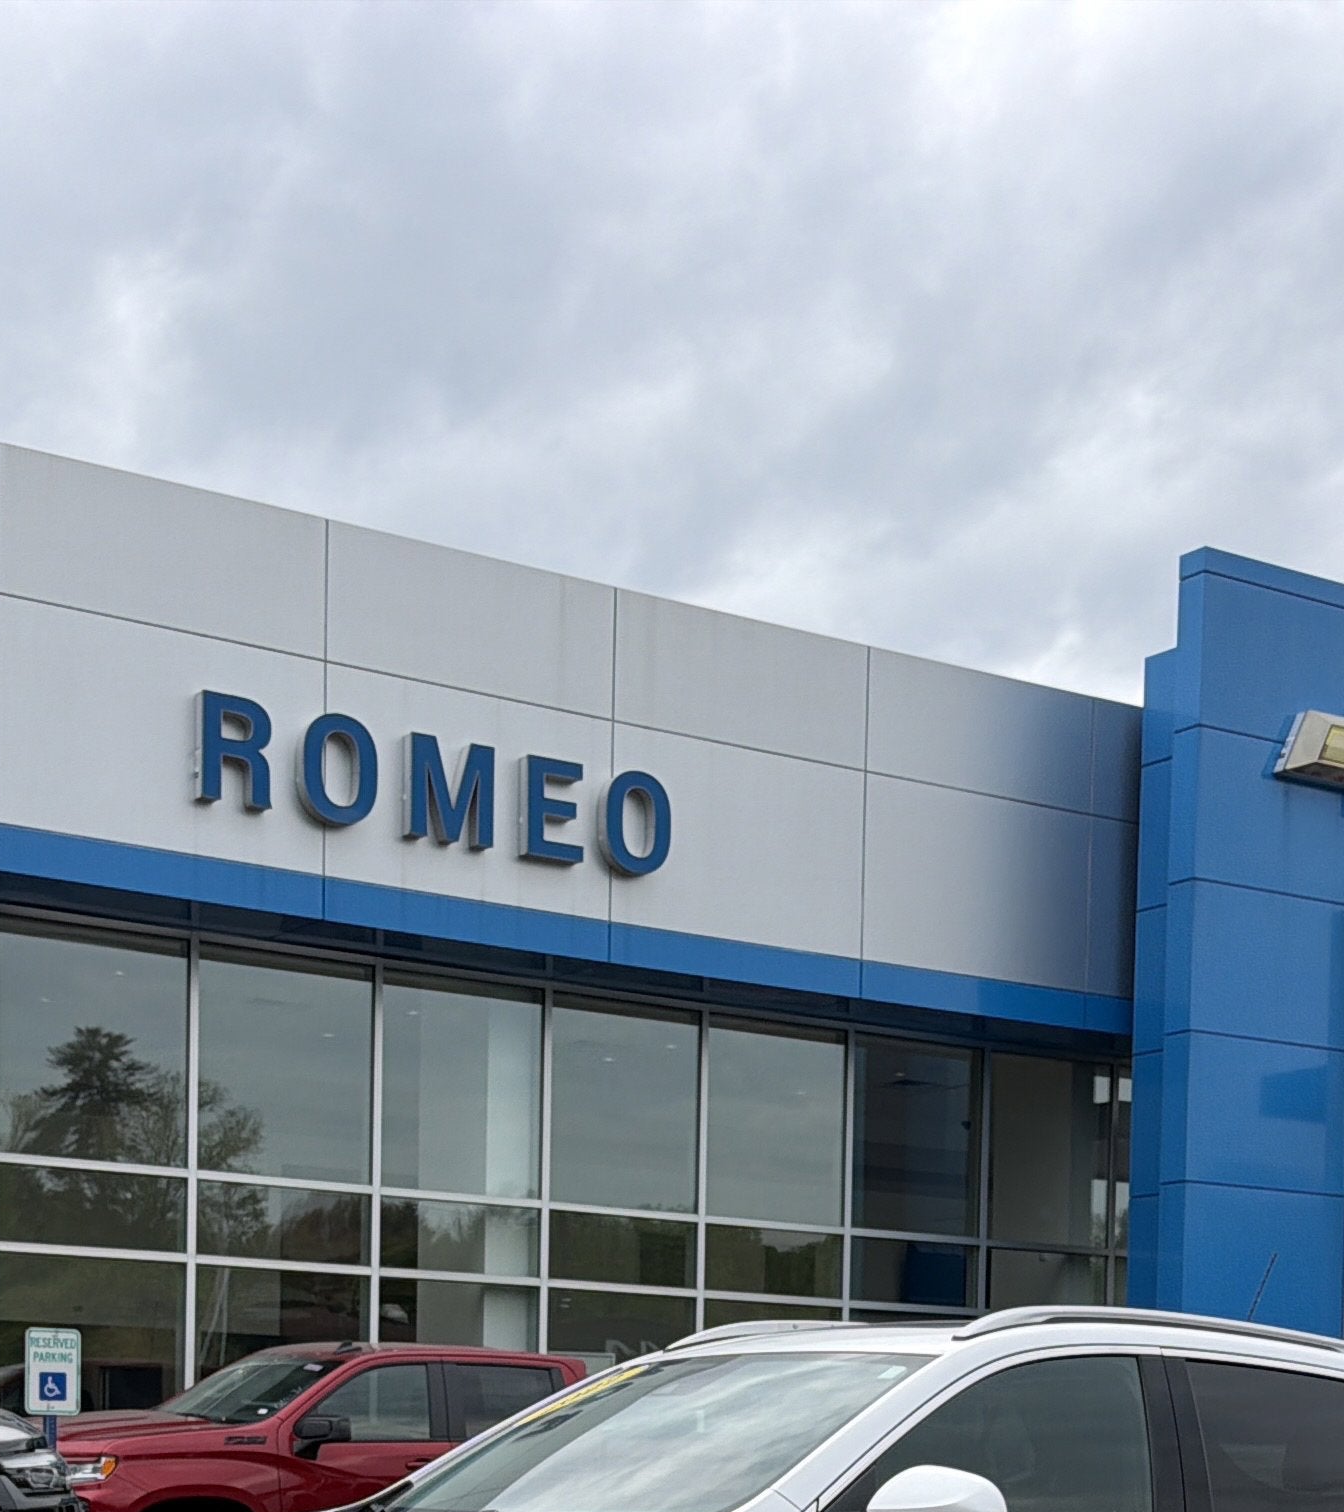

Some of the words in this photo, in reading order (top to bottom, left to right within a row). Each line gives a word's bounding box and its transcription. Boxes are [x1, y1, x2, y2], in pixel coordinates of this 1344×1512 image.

[194, 689, 672, 877] ROMEO
[29, 1335, 77, 1350] RESERVED
[33, 1351, 74, 1363] PARKING
